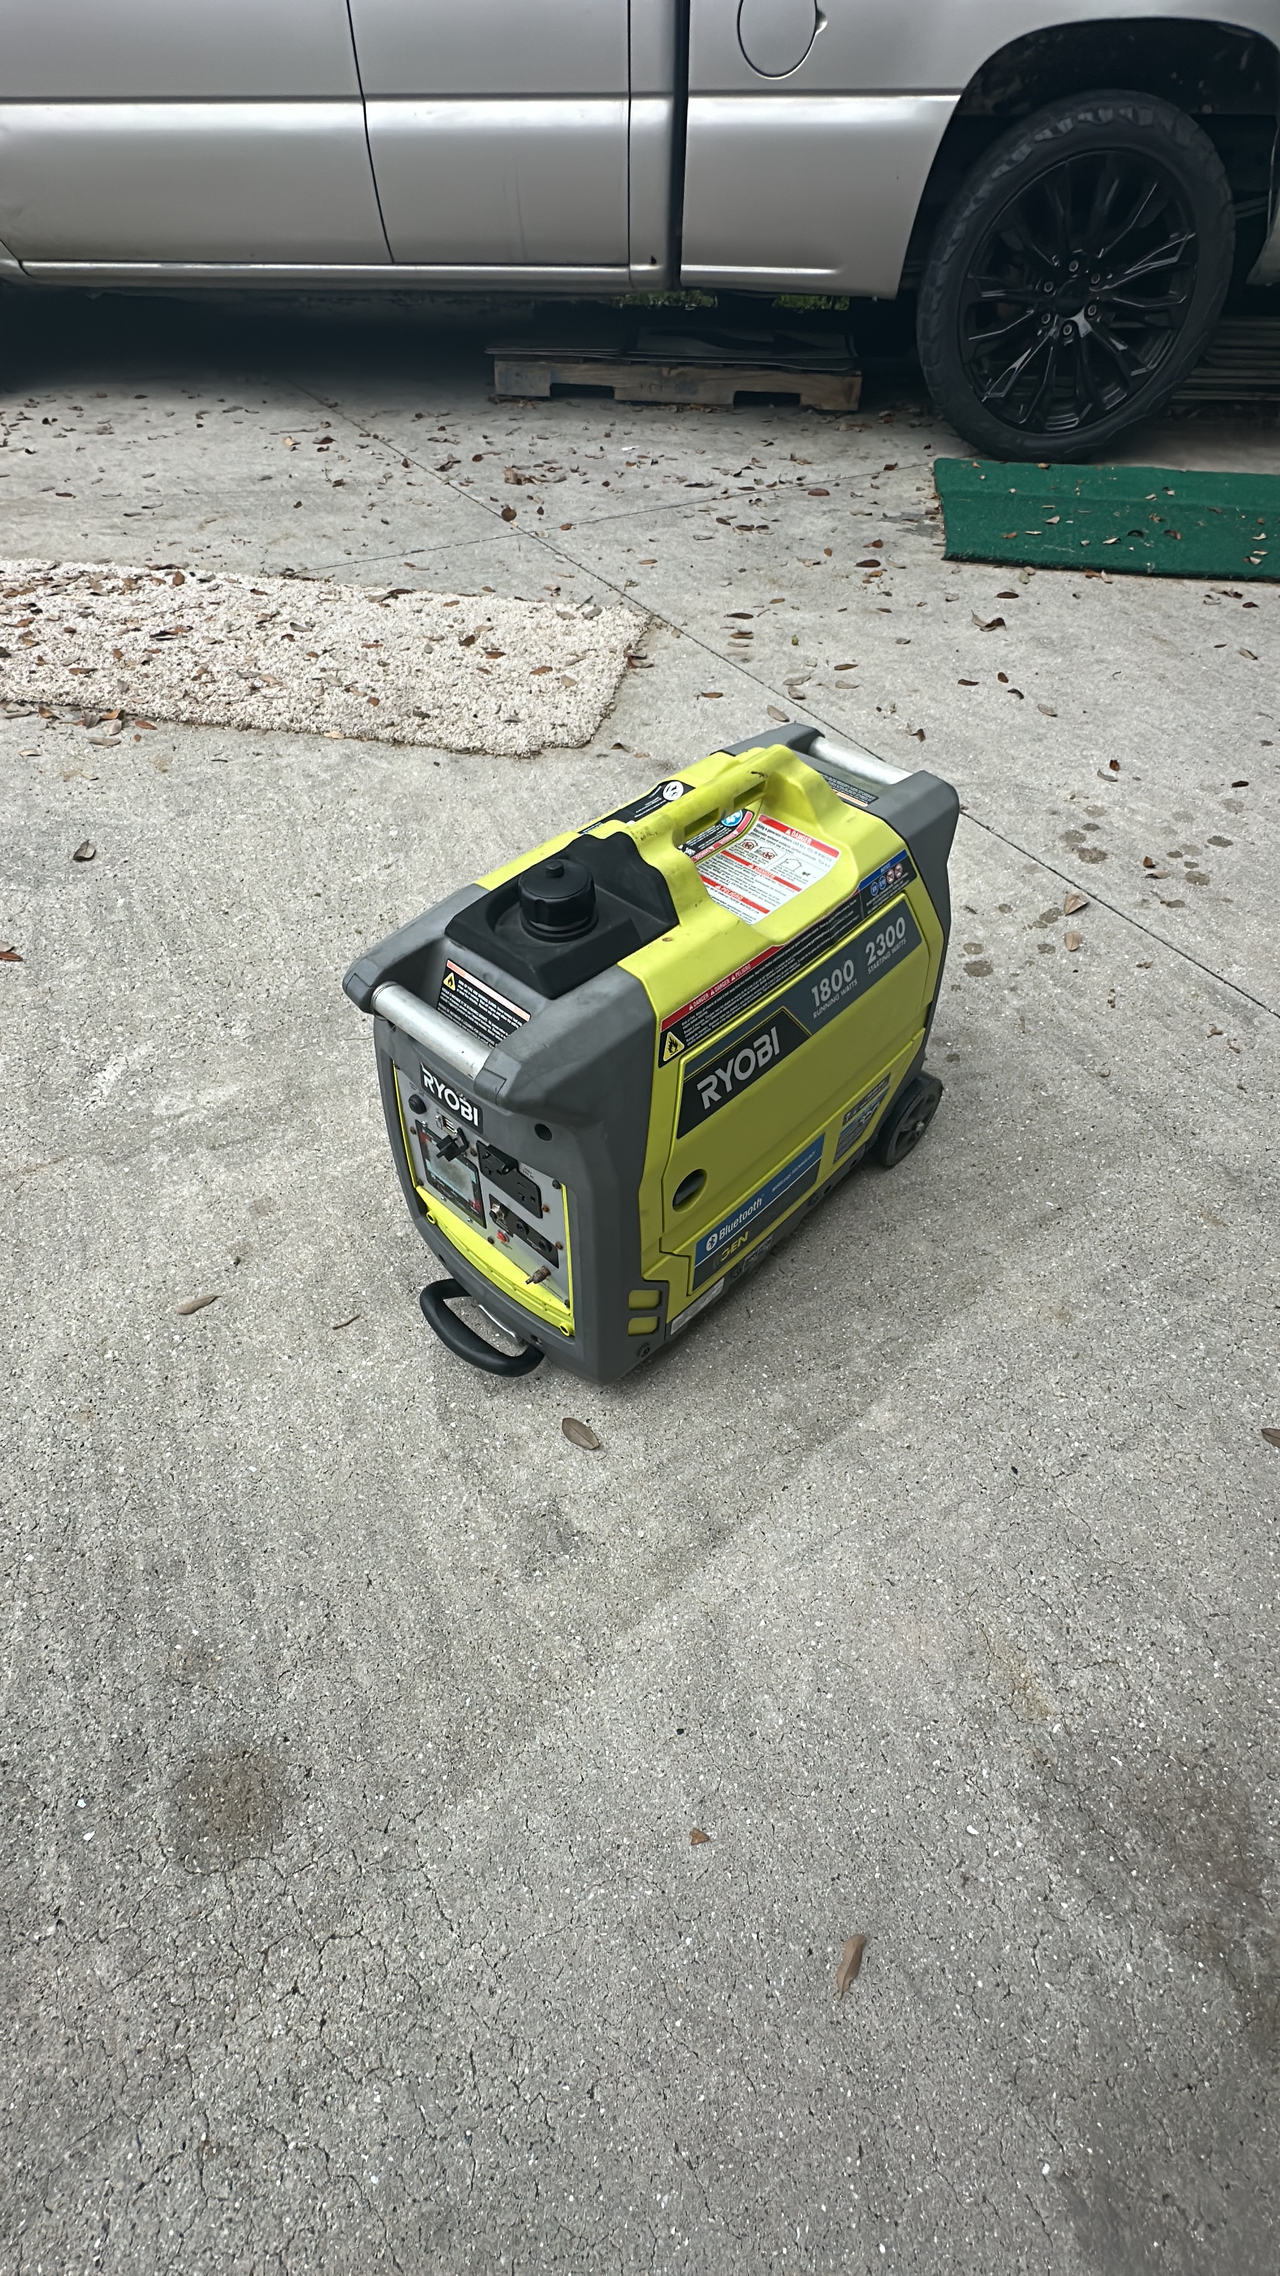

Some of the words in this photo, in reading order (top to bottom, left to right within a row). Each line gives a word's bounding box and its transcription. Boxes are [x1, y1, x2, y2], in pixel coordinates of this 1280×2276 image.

[791, 829, 813, 846] DANGER
[865, 917, 906, 966] 2300
[893, 939, 907, 957] WATTS
[811, 959, 855, 1007] 1800
[813, 994, 839, 1018] RUNNING
[841, 980, 858, 998] WATTS
[696, 1026, 780, 1110] RYOBI
[420, 1062, 479, 1127] RYOBI
[719, 1198, 763, 1240] Bluetooth
